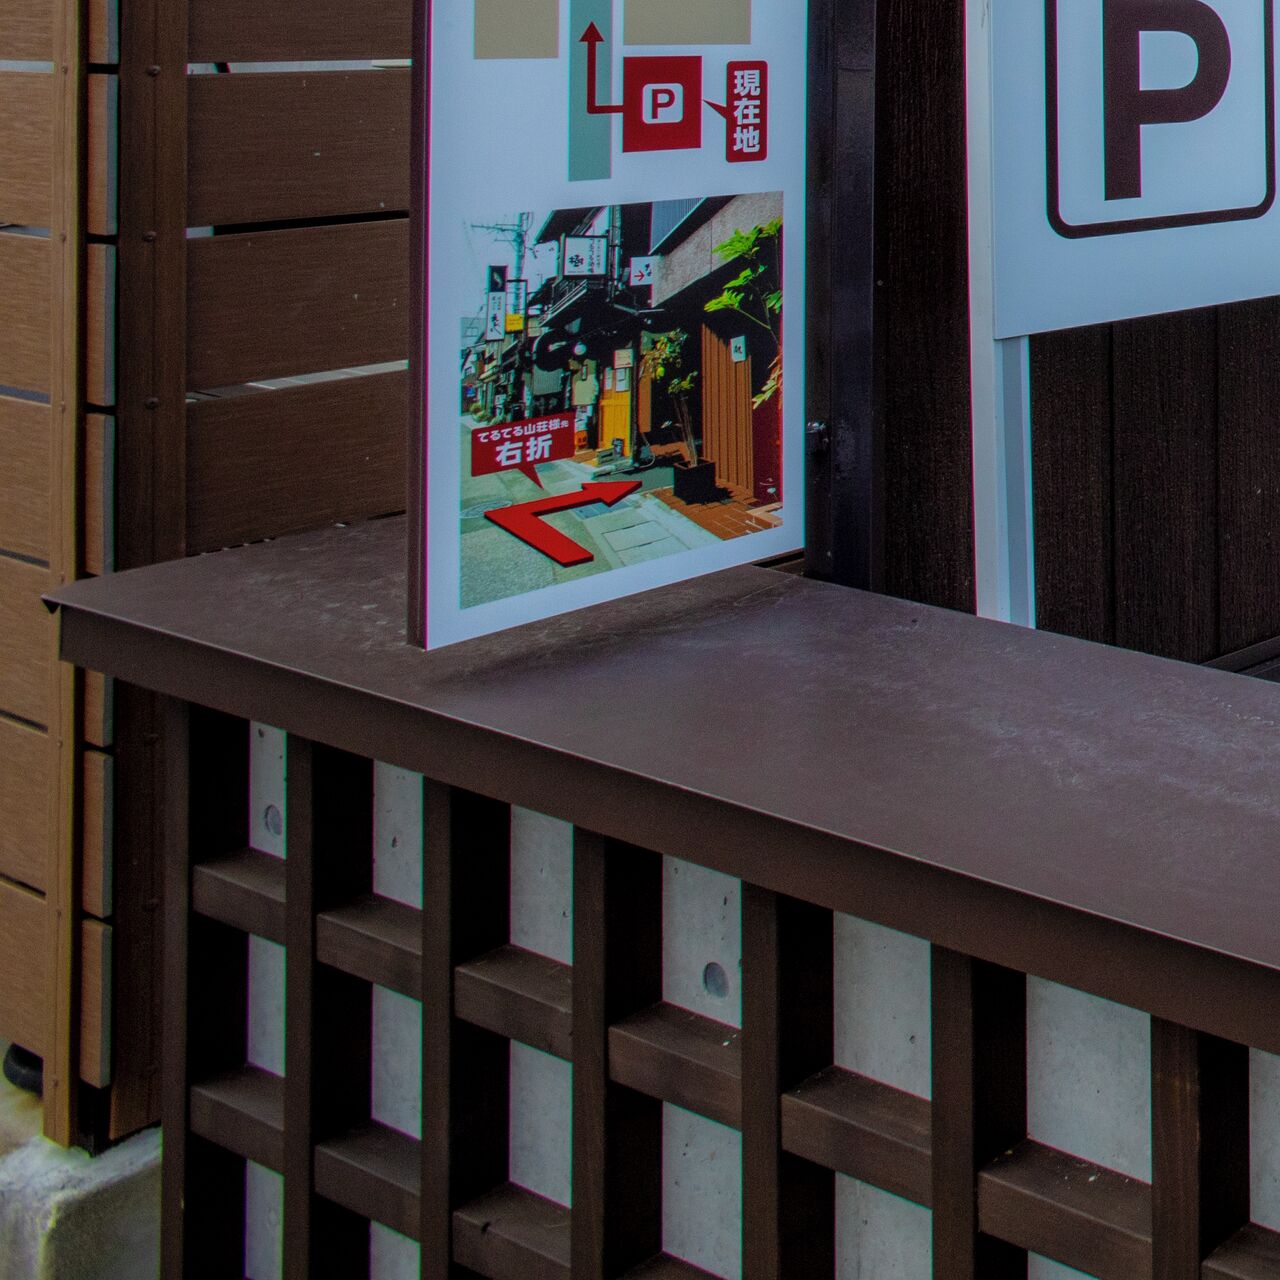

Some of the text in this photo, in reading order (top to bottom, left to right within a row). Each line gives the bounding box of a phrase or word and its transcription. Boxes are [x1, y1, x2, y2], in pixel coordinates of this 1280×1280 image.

[651, 88, 676, 120] P
[733, 69, 760, 154] 現在地
[496, 433, 553, 467] 右折
